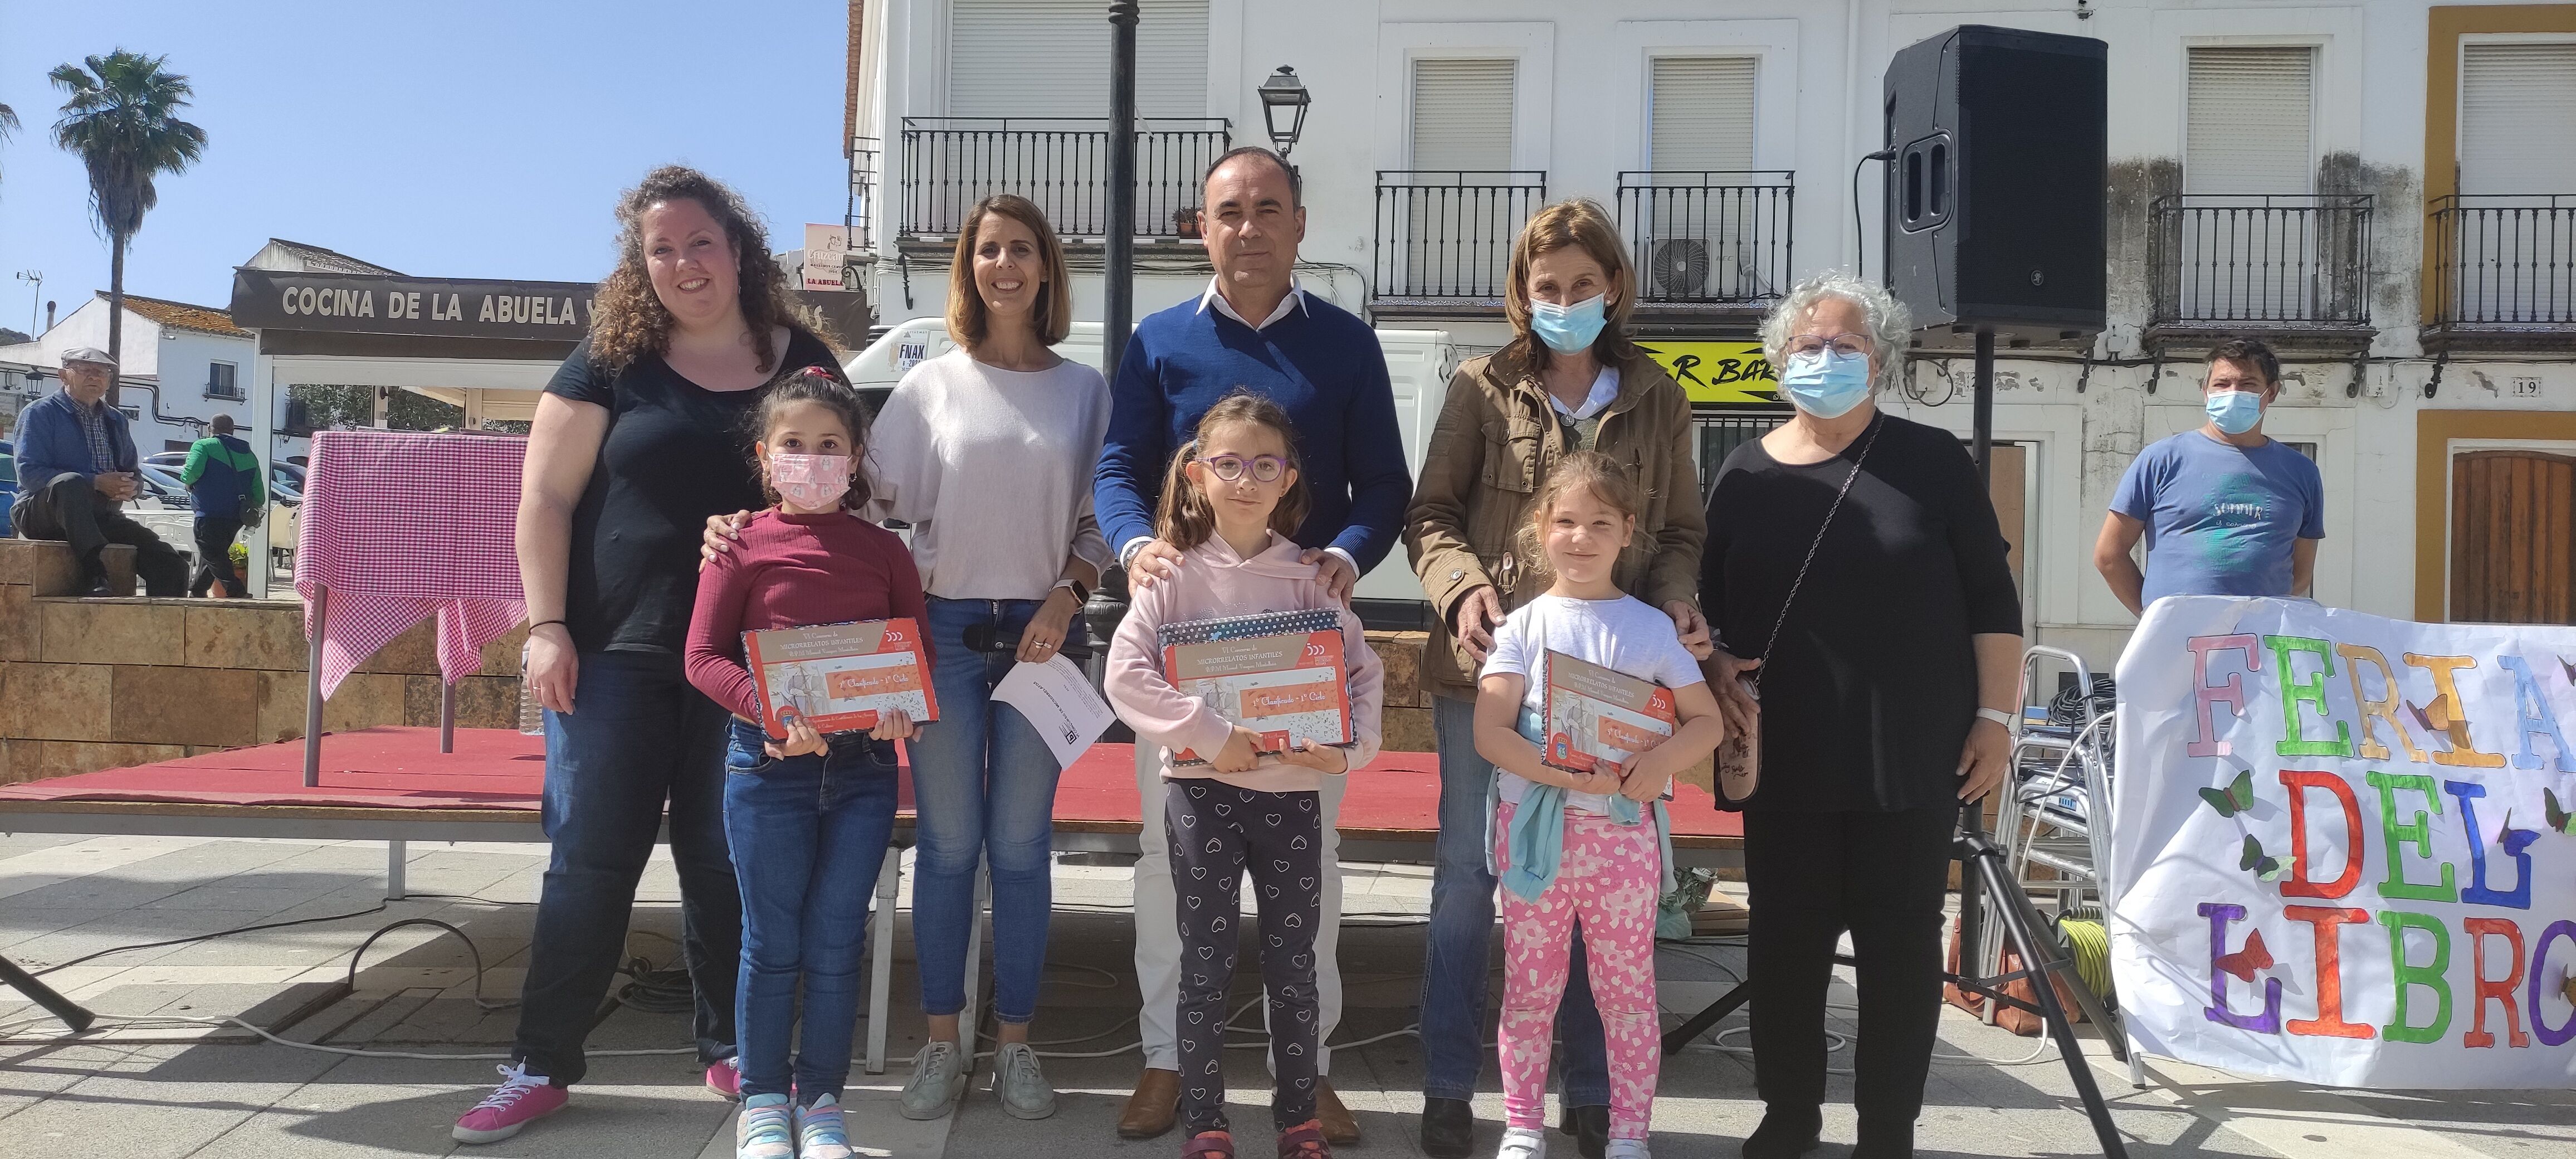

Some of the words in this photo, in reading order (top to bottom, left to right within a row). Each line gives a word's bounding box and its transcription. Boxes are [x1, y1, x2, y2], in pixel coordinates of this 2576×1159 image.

[282, 286, 374, 318] COCINA
[388, 291, 420, 319] DE
[432, 293, 462, 321] LA
[479, 295, 575, 325] ABUELA
[1712, 359, 1778, 385] BAR
[2519, 382, 2536, 393] 19
[780, 640, 829, 650] MICRORRELATOS
[1197, 654, 1247, 665] MICRORRELATOS
[1249, 651, 1282, 660] INFANTILES
[847, 676, 879, 688] Clasificado
[892, 674, 909, 682] Ciclo
[1568, 672, 1607, 689] MICRORRELATOS
[1608, 685, 1635, 698] INFANTILES
[1261, 694, 1294, 707] Clasificado
[1309, 691, 1325, 700] Ciclo
[2187, 633, 2576, 773] FERIA
[2279, 770, 2531, 909] DEL
[2197, 902, 2576, 1048] LIBRO
